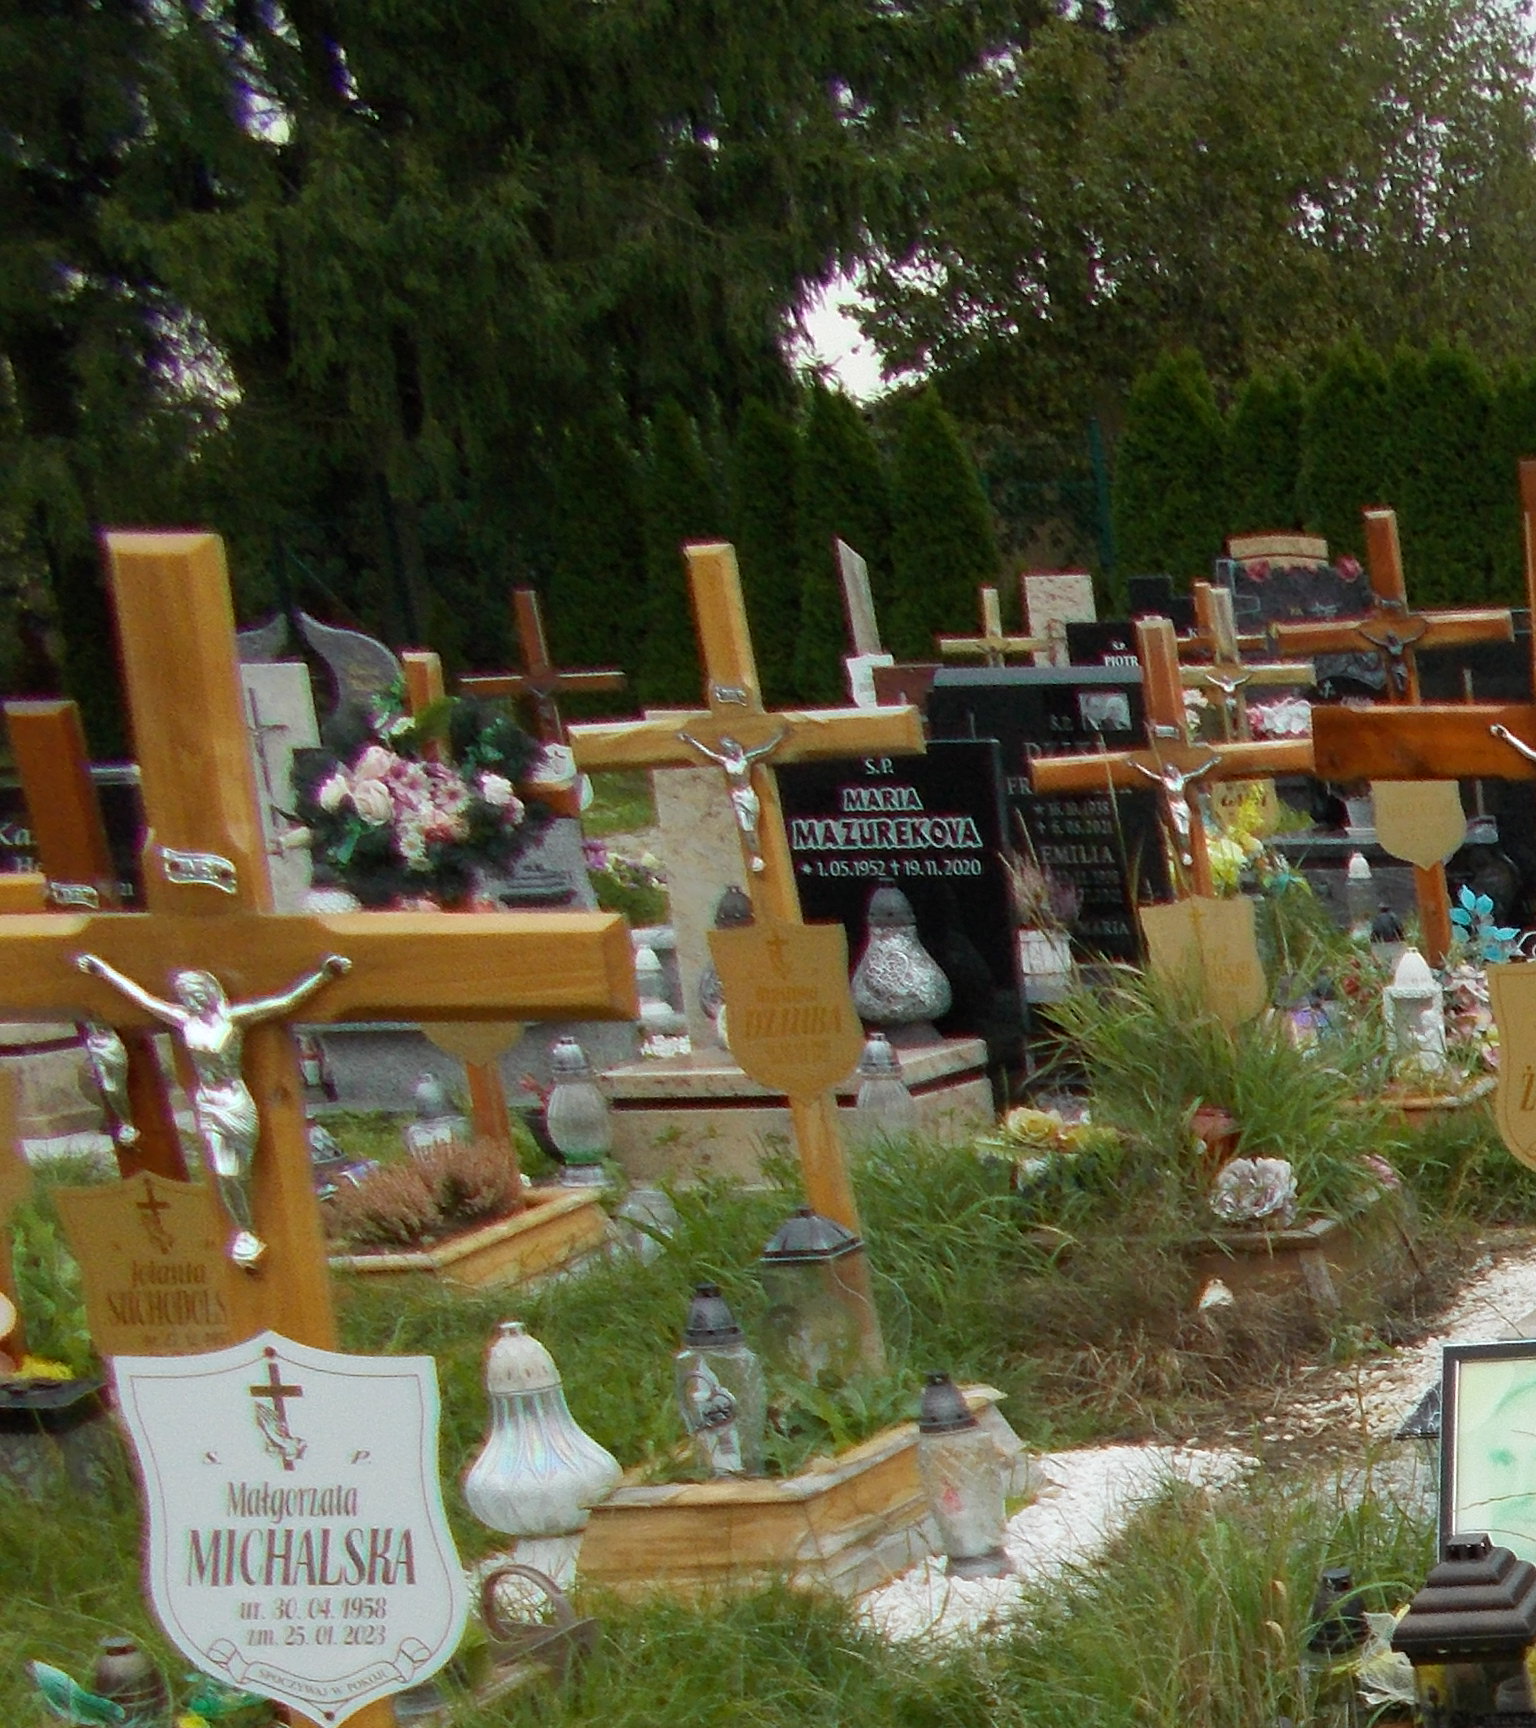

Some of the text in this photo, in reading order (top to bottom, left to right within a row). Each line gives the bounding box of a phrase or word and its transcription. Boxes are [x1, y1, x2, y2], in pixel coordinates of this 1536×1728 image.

[1104, 656, 1138, 668] PIOTR
[844, 787, 924, 812] MARIA
[817, 858, 982, 877] 1.05.1952 19.11.2020
[1040, 846, 1116, 864] EMILIA
[226, 1480, 359, 1525] Małgorzata
[187, 1527, 418, 1588] MICHALSKA
[238, 1600, 267, 1621] ur.
[341, 1596, 388, 1620] 1958
[246, 1627, 279, 1647] zm.
[284, 1623, 310, 1647] 25.
[343, 1623, 387, 1646] 2023
[258, 1667, 328, 1698] SPOCZYWAJ
[346, 1669, 389, 1694] POKOJU
